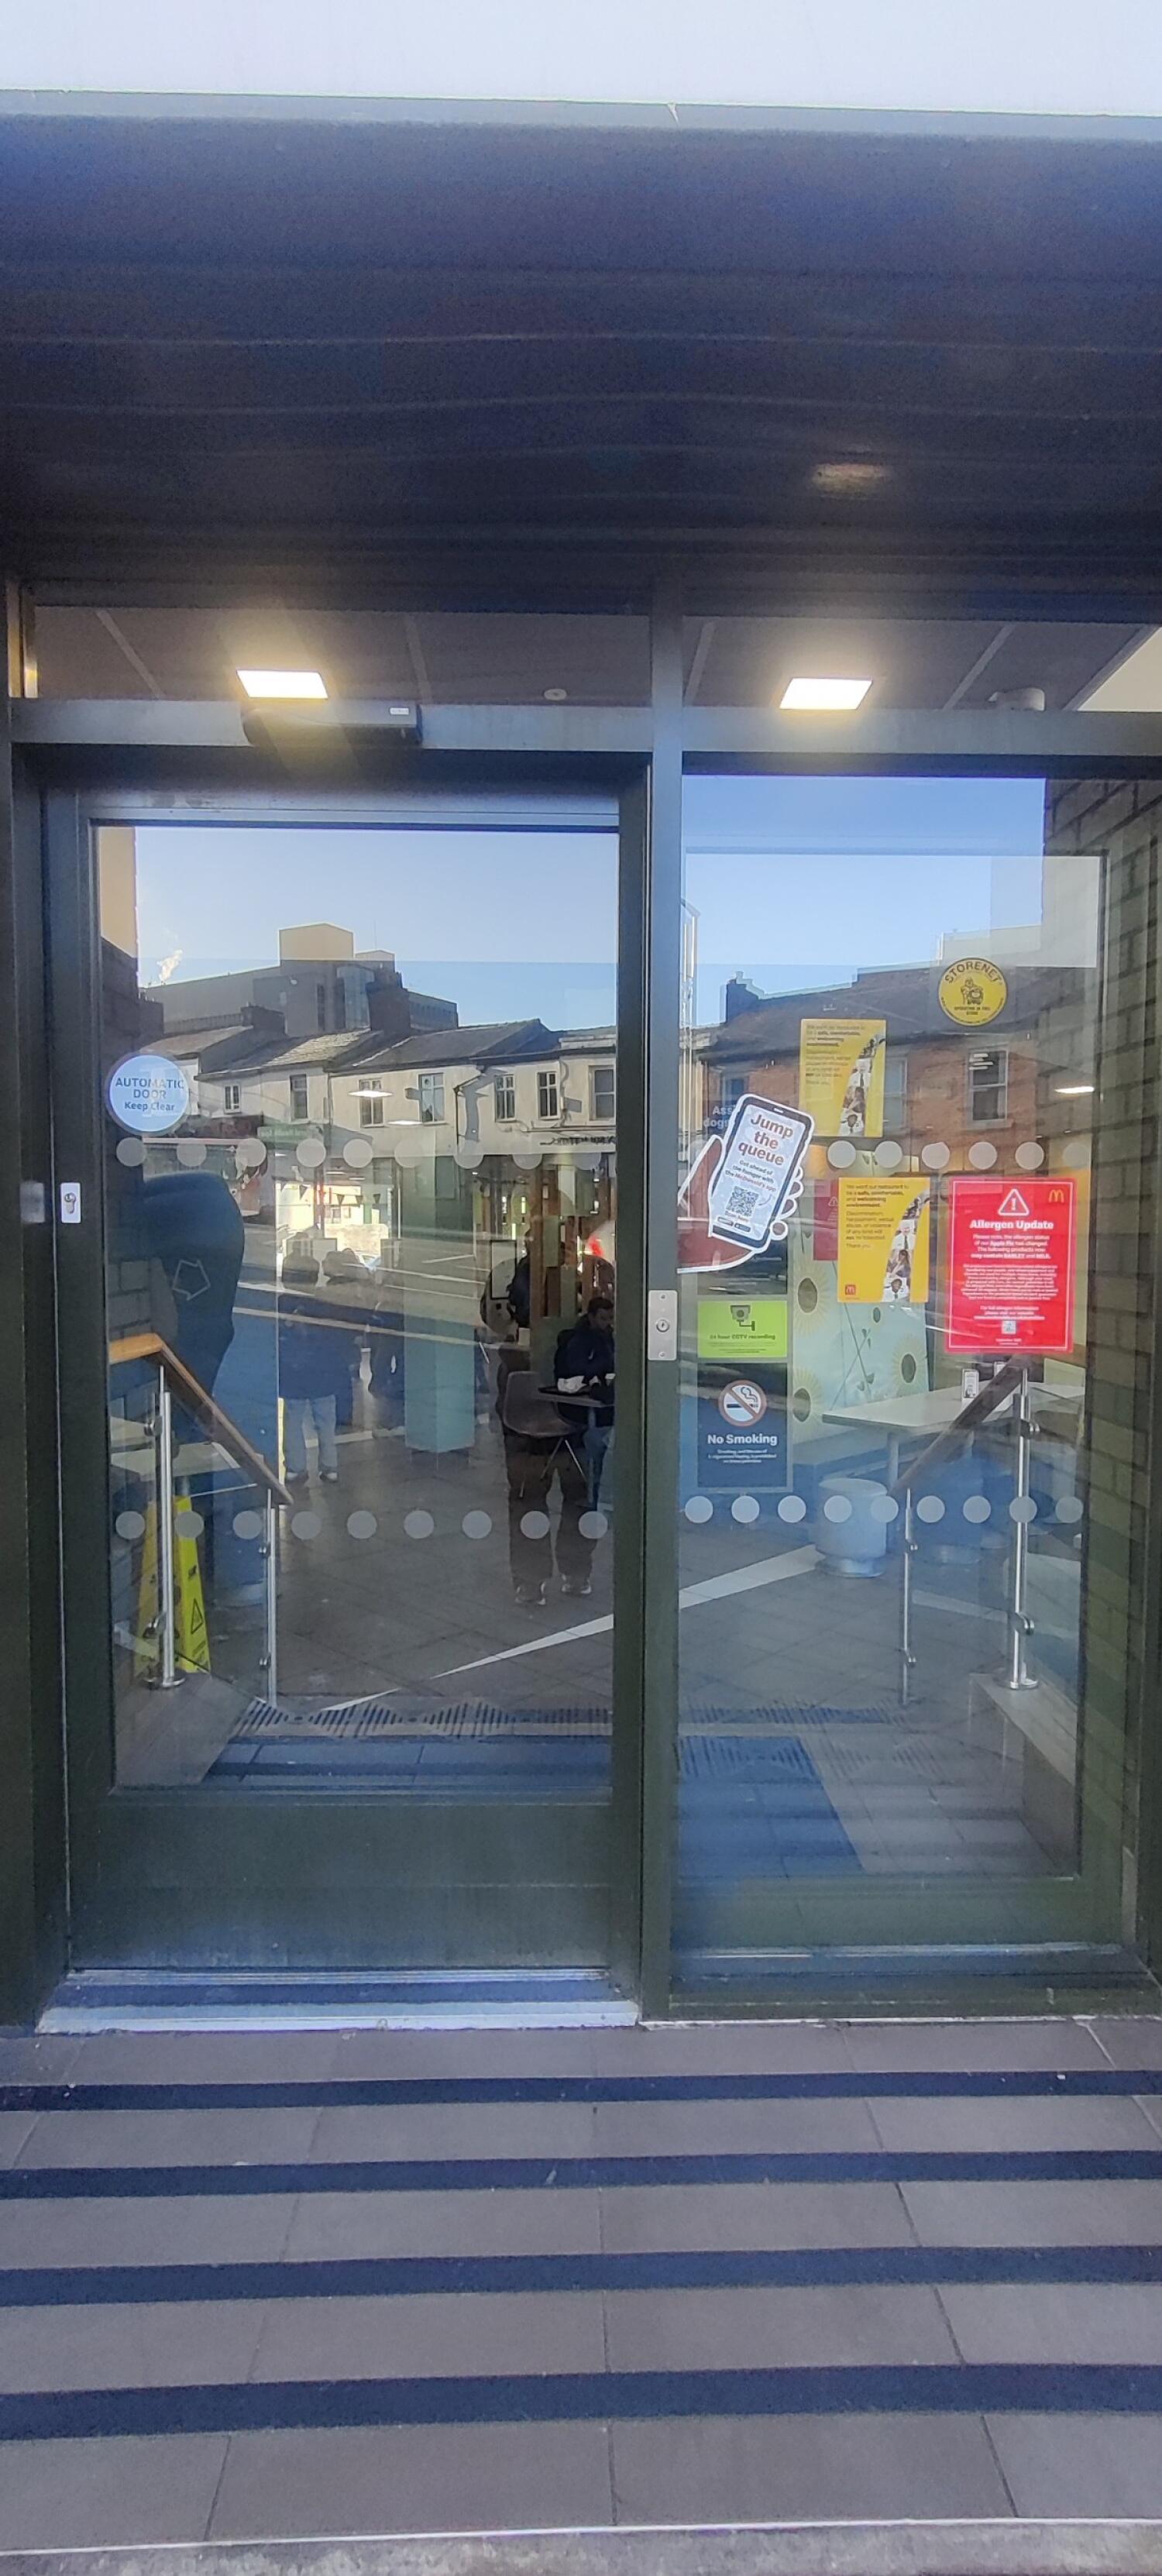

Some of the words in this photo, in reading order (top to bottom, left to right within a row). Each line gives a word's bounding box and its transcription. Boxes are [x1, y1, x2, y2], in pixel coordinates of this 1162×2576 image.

[945, 961, 1002, 984] STORENET
[115, 1078, 184, 1089] AUTOMATIC
[133, 1089, 167, 1099] DOOR
[124, 1101, 148, 1112] Keep
[150, 1102, 175, 1111] Clear
[712, 1106, 735, 1116] Ass
[751, 1114, 794, 1139] Jump
[754, 1130, 779, 1148] the
[738, 1142, 784, 1166] queue
[969, 1219, 1014, 1231] Allergen
[1016, 1220, 1054, 1231] Update
[707, 1434, 724, 1444] No
[726, 1433, 778, 1446] Smoking
